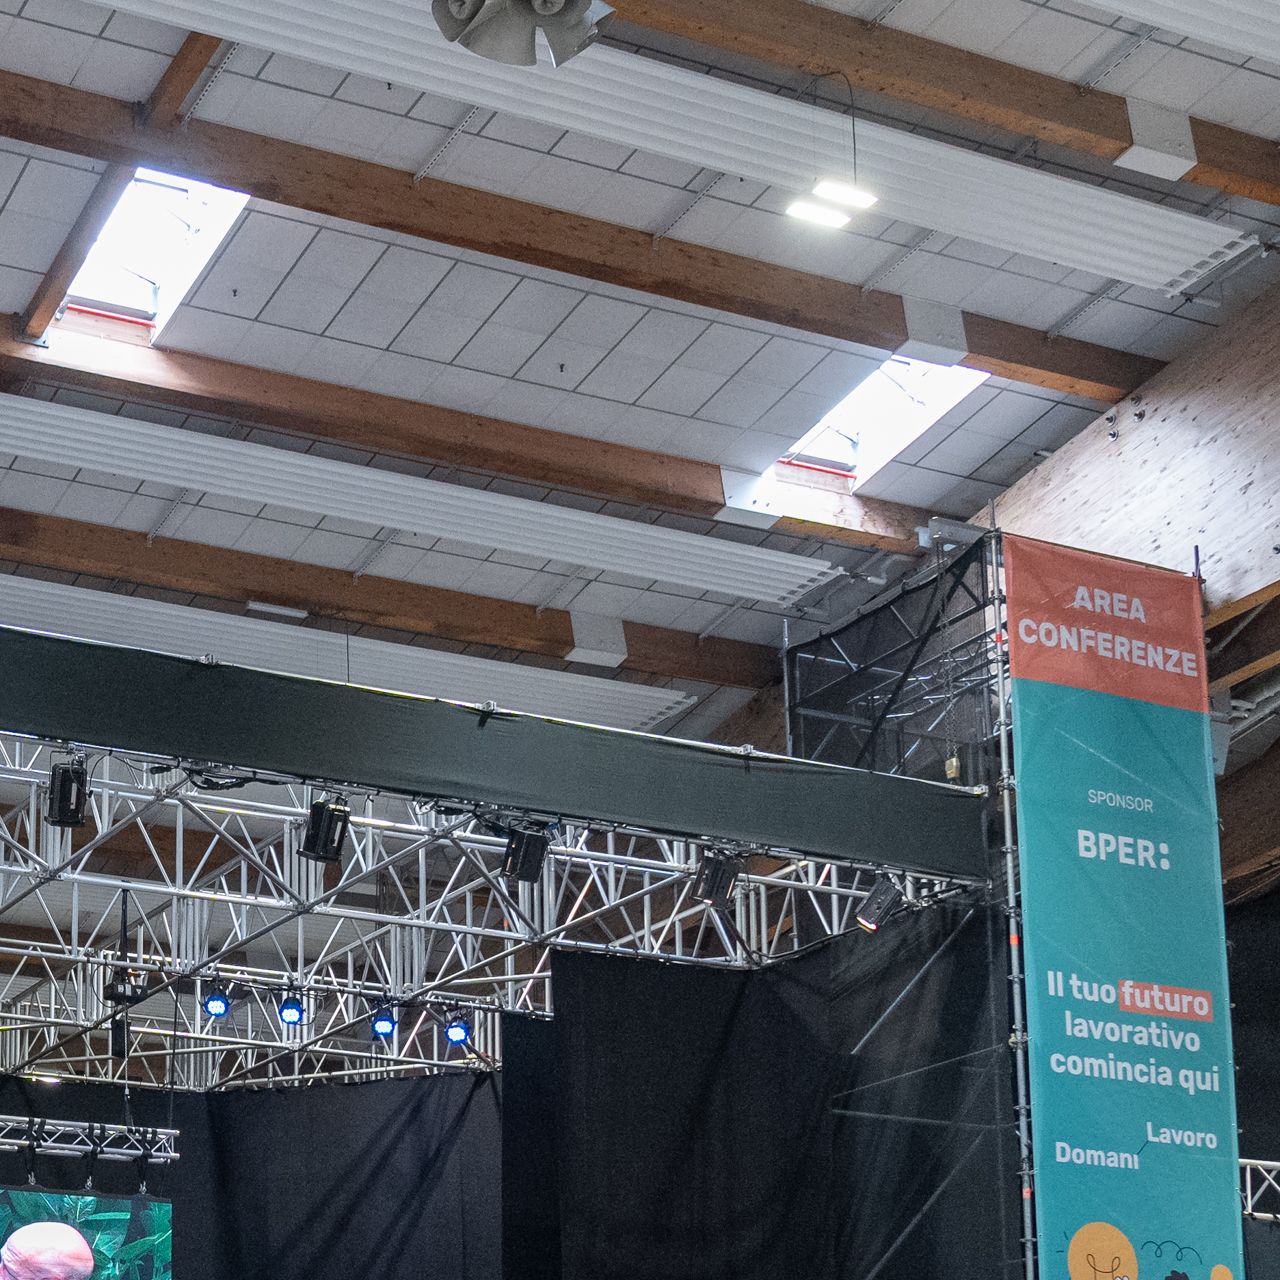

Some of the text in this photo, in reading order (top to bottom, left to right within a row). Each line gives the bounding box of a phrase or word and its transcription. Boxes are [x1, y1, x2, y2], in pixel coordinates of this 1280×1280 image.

[1073, 585, 1146, 623] AREA
[1019, 618, 1198, 677] CONFERENZE
[1087, 789, 1153, 813] SPONSOR
[1047, 970, 1209, 1016] Il tuo futuro
[1065, 1010, 1201, 1052] lavorativo
[1050, 1053, 1220, 1095] comincia qui
[1055, 1141, 1139, 1170] Domani
[1146, 1122, 1217, 1149] Lavoro
